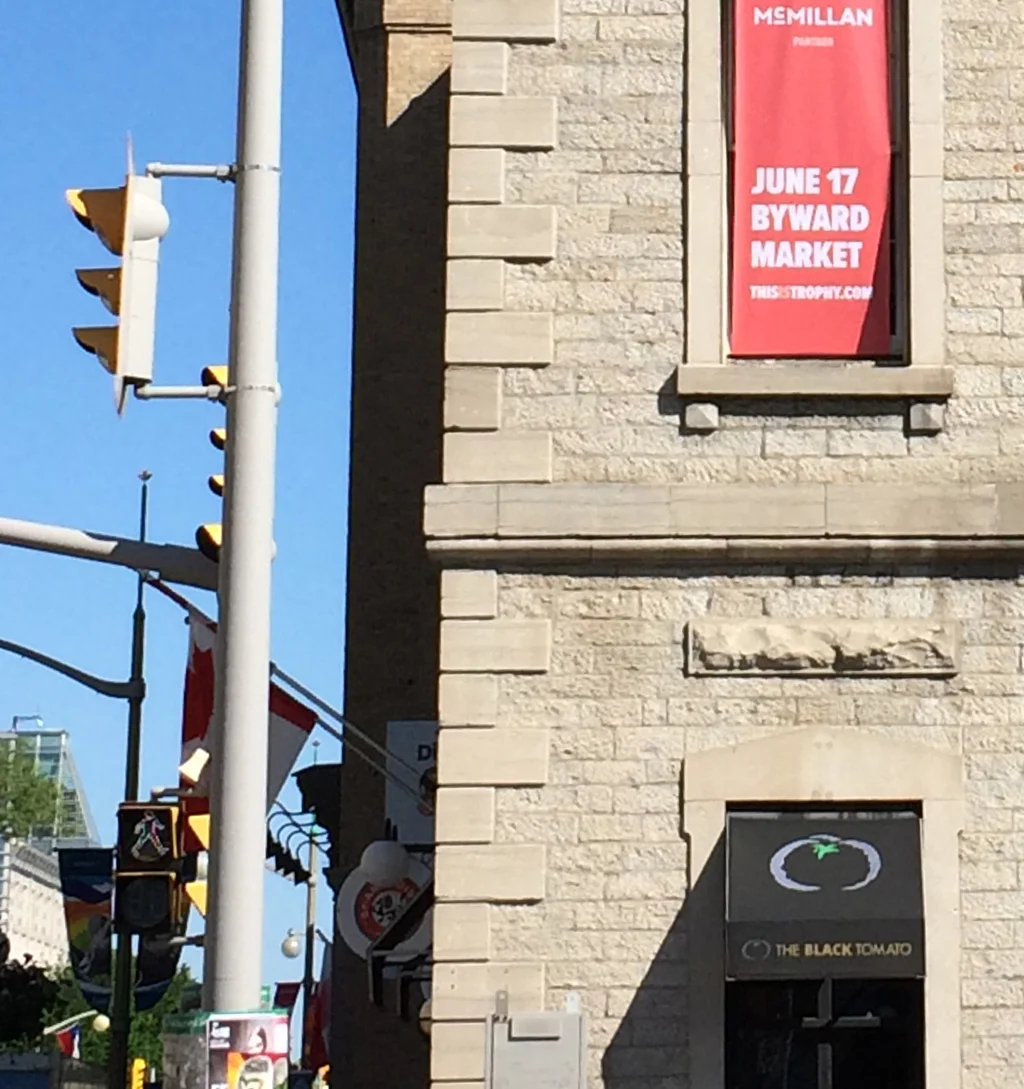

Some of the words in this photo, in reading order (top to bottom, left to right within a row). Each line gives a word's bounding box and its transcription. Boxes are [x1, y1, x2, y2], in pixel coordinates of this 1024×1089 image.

[750, 166, 821, 195] JUNE
[825, 167, 860, 195] 17
[751, 203, 871, 232] BYWARD
[751, 239, 864, 269] MARKET
[775, 943, 800, 957] THE
[804, 942, 852, 957] BLACK
[855, 942, 912, 957] TOMATO
